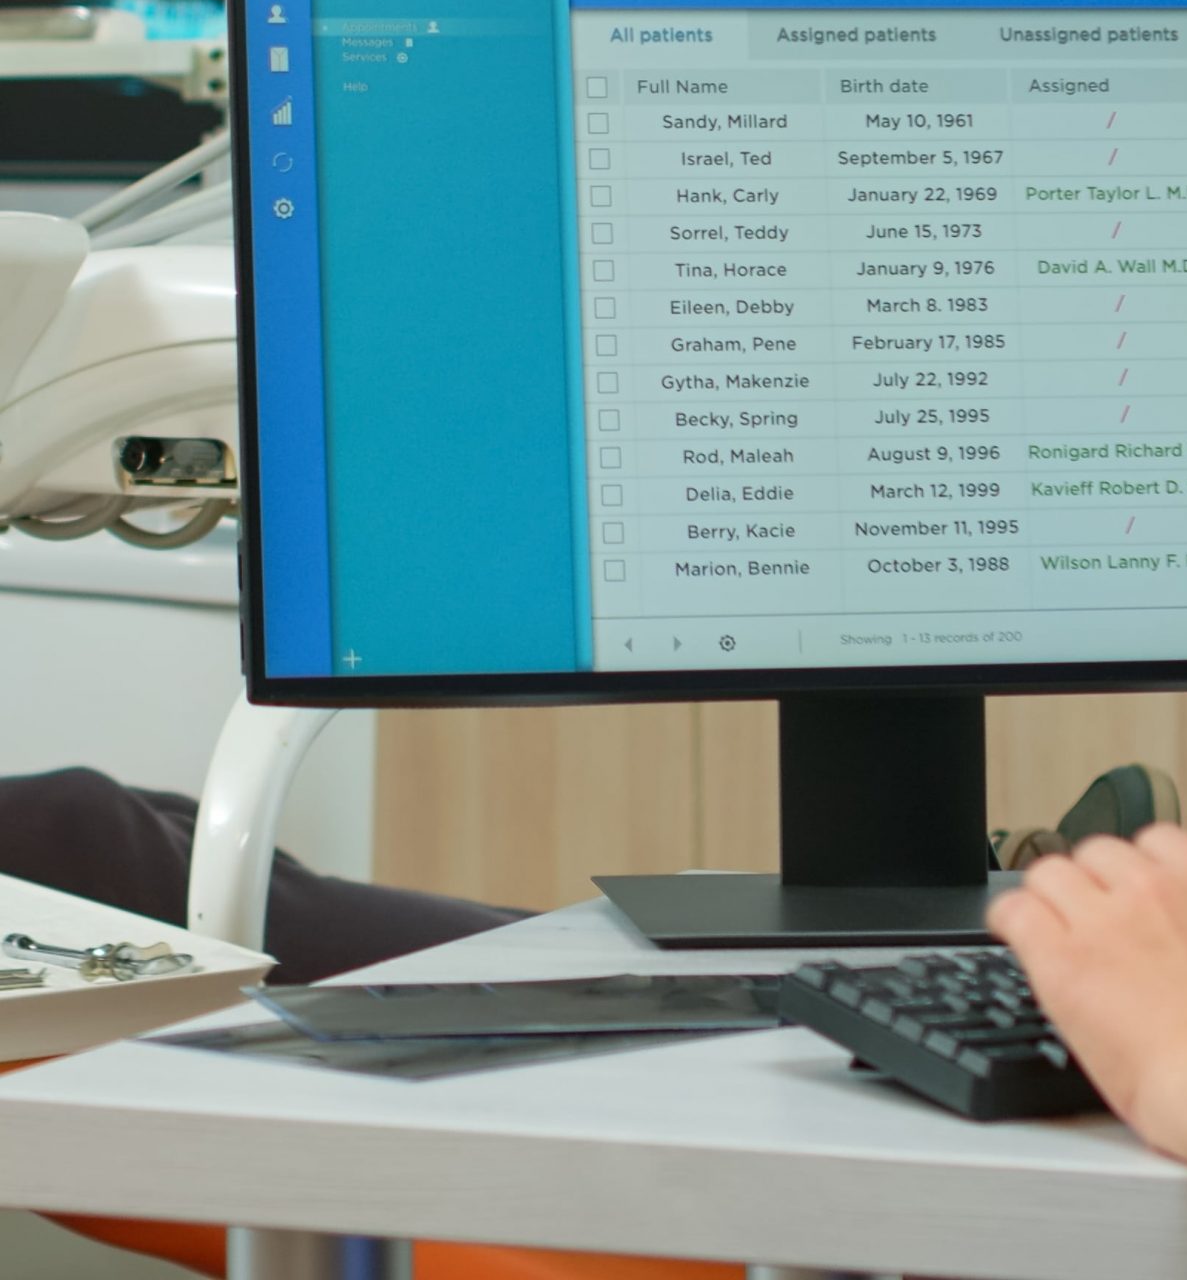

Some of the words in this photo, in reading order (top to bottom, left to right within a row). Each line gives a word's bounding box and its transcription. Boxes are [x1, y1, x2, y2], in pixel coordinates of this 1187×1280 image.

[342, 37, 393, 48] Messages
[610, 27, 634, 42] All
[640, 28, 713, 45] patients
[777, 27, 858, 45] Assigned
[864, 28, 936, 45] patients
[1000, 27, 1101, 44] Unassigned
[1107, 27, 1178, 44] patients
[342, 52, 388, 63] Services
[343, 81, 369, 93] Help
[637, 79, 669, 94] Full
[676, 80, 728, 94] Name
[840, 79, 883, 93] Birth
[889, 79, 929, 93] date
[1028, 78, 1109, 95] Assigned
[663, 115, 721, 131] Sandy,
[728, 114, 787, 128] Millard
[866, 114, 901, 131] May
[907, 114, 931, 130] 10,
[937, 114, 973, 128] 1961
[681, 151, 733, 168] Israel,
[740, 151, 771, 165] Ted
[838, 150, 936, 167] September
[942, 150, 958, 167] 5,
[963, 150, 1003, 164] 1967
[677, 188, 727, 205] Hank,
[733, 188, 779, 205] Carly
[848, 188, 918, 204] January
[924, 187, 950, 203] 22,
[956, 187, 997, 201] 1969
[1026, 187, 1081, 200] Porter
[1086, 186, 1140, 203] Taylor
[1145, 186, 1160, 200] L.
[670, 225, 728, 242] Sorrel,
[734, 225, 789, 242] Teddy
[866, 225, 908, 239] June
[914, 224, 937, 240] 15,
[942, 224, 982, 238] 1973
[674, 263, 717, 279] Tina,
[724, 263, 787, 277] Horace
[856, 262, 927, 278] January
[933, 261, 949, 277] 9,
[954, 260, 995, 275] 1976
[1038, 260, 1088, 274] David
[1094, 260, 1112, 273] A.
[1117, 259, 1156, 273] Wall
[670, 300, 730, 316] Eileen,
[736, 299, 794, 316] Debby
[867, 298, 920, 312] March
[947, 298, 988, 312] 1983
[671, 337, 746, 354] Graham,
[753, 337, 796, 351] Pene
[852, 335, 933, 352] February
[938, 335, 959, 351] 17,
[965, 334, 1005, 349] 1985
[661, 375, 719, 392] Gytha,
[726, 373, 810, 389] Makenzie
[873, 372, 909, 389] July
[916, 372, 942, 388] 22,
[947, 371, 988, 386] 1992
[676, 412, 733, 429] Becky,
[739, 411, 798, 428] Spring
[875, 409, 911, 427] July
[917, 409, 943, 425] 25,
[949, 409, 990, 423] 1995
[683, 449, 724, 466] Rod,
[730, 448, 793, 463] Maleah
[867, 447, 931, 464] August
[937, 446, 952, 462] 9,
[958, 445, 1000, 460] 1996
[1028, 444, 1109, 461] Ronigard
[1115, 443, 1182, 458] Richard
[686, 486, 736, 503] Delia,
[742, 486, 794, 500] Eddie
[871, 484, 924, 499] March
[930, 483, 953, 500] 12,
[958, 482, 1000, 497] 1999
[1031, 481, 1094, 496] Kavieff
[1099, 481, 1160, 495] Robert
[1166, 480, 1183, 494] D.
[688, 525, 739, 541] Berry,
[746, 523, 795, 538] Kacie
[855, 521, 948, 536] November
[953, 520, 972, 536] 11,
[978, 520, 1019, 534] 1995
[675, 561, 742, 578] Marion,
[748, 560, 810, 575] Bennie
[867, 558, 942, 573] October
[948, 557, 963, 574] 3,
[968, 557, 1009, 571] 1988
[1040, 555, 1101, 570] Wilson
[1107, 555, 1160, 571] Lanny
[1166, 554, 1180, 568] F.
[840, 634, 893, 646] Showing
[934, 633, 979, 644] records
[982, 631, 995, 643] of
[998, 631, 1023, 642] 200
